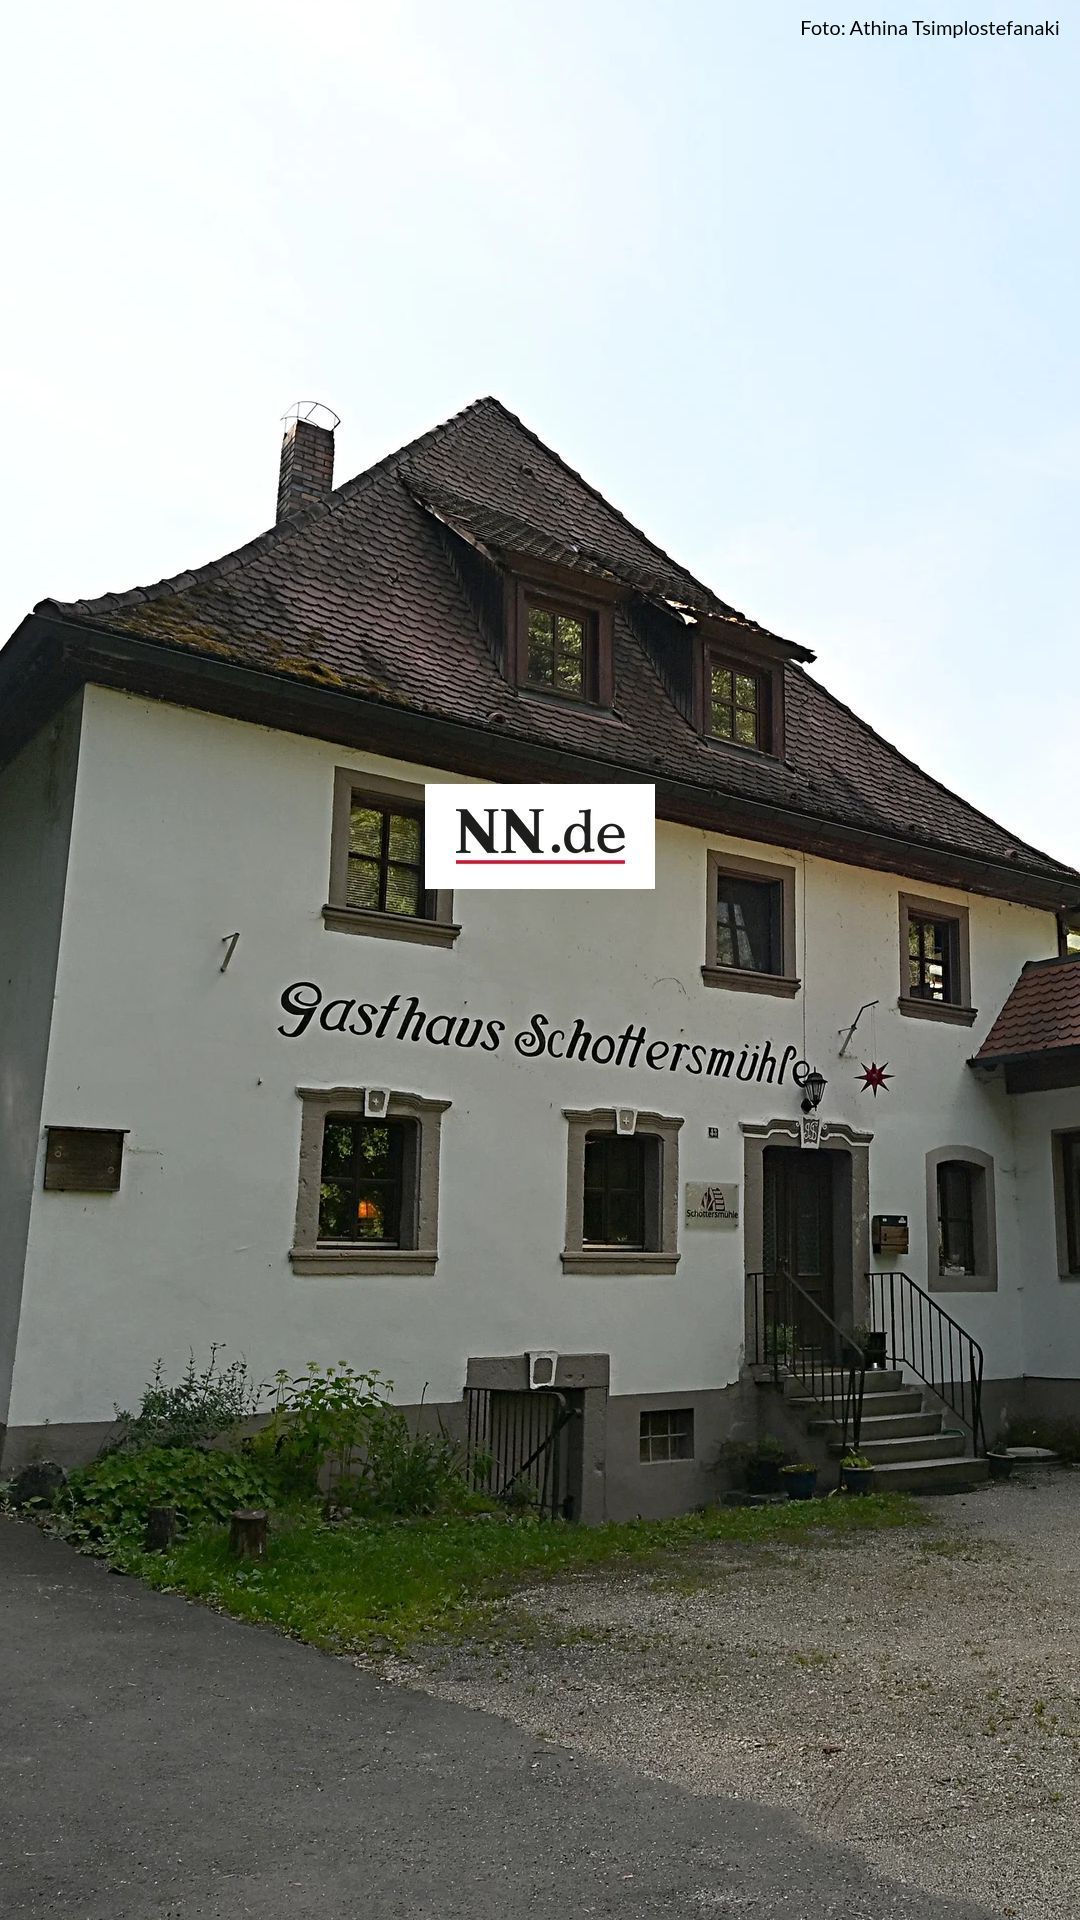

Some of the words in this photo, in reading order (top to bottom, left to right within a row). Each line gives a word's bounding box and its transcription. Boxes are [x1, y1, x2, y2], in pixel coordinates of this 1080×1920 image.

[277, 981, 506, 1052] Gasthaus
[514, 1013, 811, 1089] Schottersmühle
[686, 1209, 739, 1219] Schottersmühle
